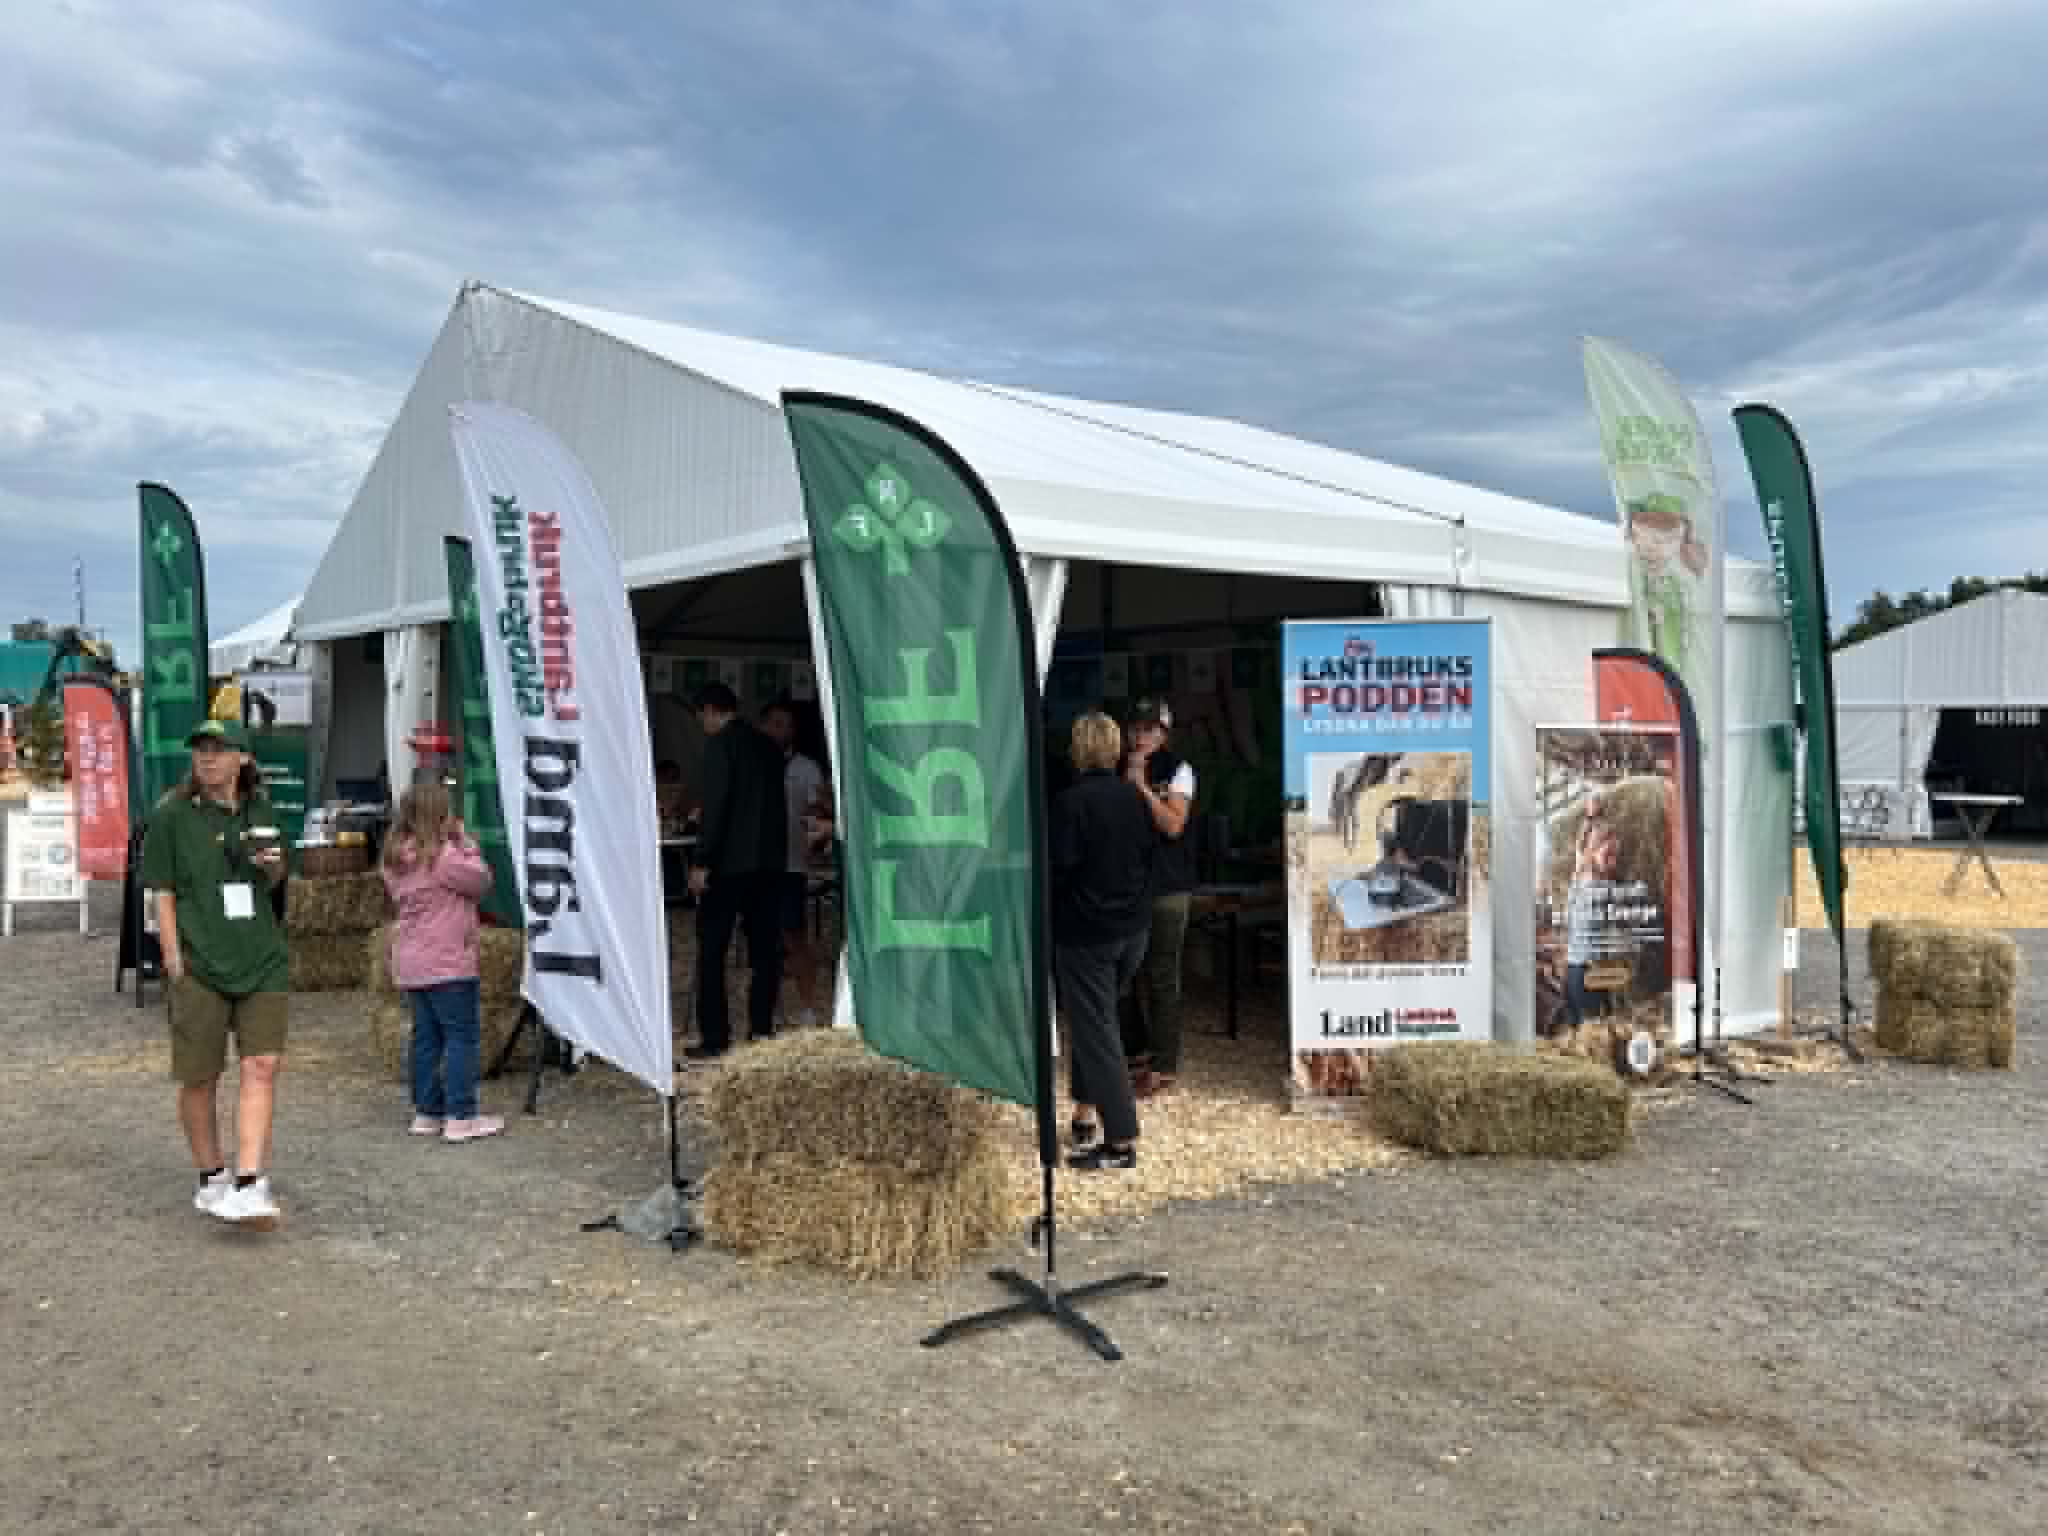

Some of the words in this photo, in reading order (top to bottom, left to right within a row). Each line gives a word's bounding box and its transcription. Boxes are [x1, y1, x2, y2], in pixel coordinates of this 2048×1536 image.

[1302, 655, 1473, 680] LANTBRUKS
[1302, 681, 1473, 714] PODDEN
[1320, 1006, 1392, 1038] Land
